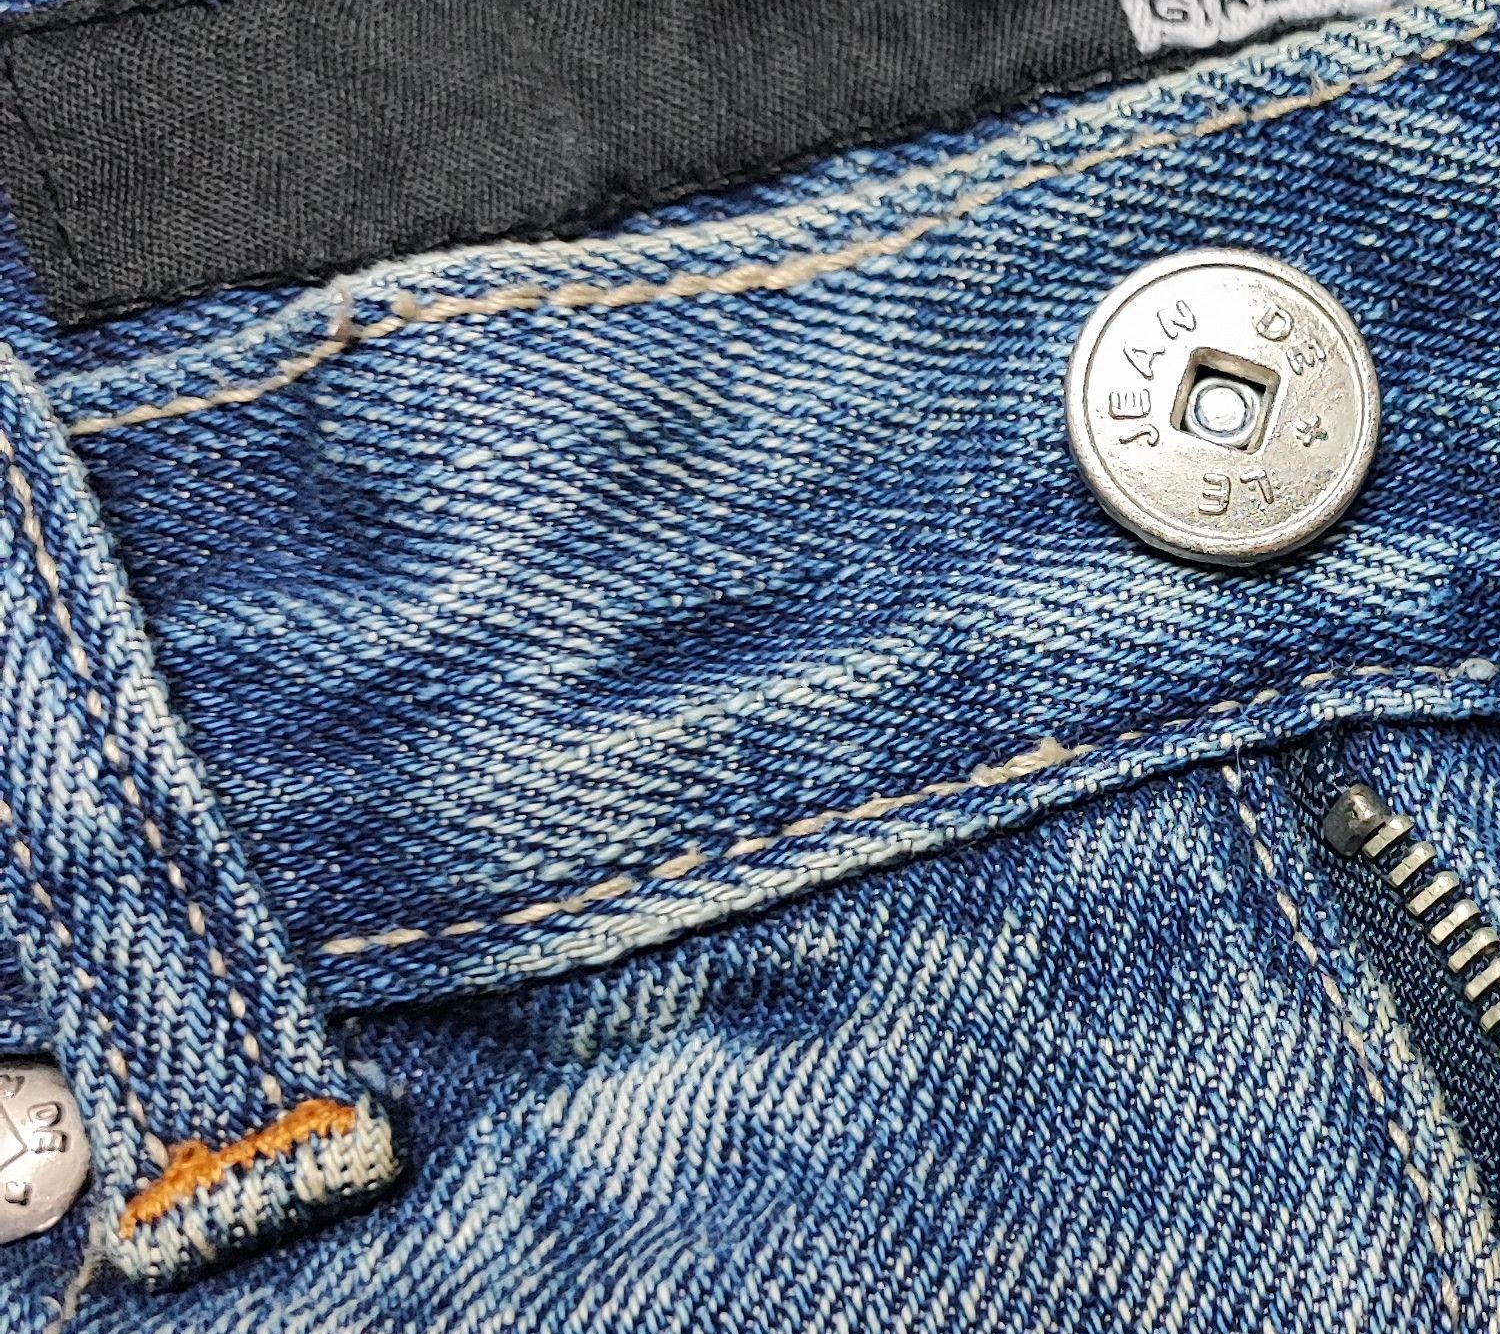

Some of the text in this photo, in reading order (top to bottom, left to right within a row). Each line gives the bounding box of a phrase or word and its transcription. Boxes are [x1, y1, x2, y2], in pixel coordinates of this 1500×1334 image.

[1108, 299, 1327, 516] LE JEAN DE
